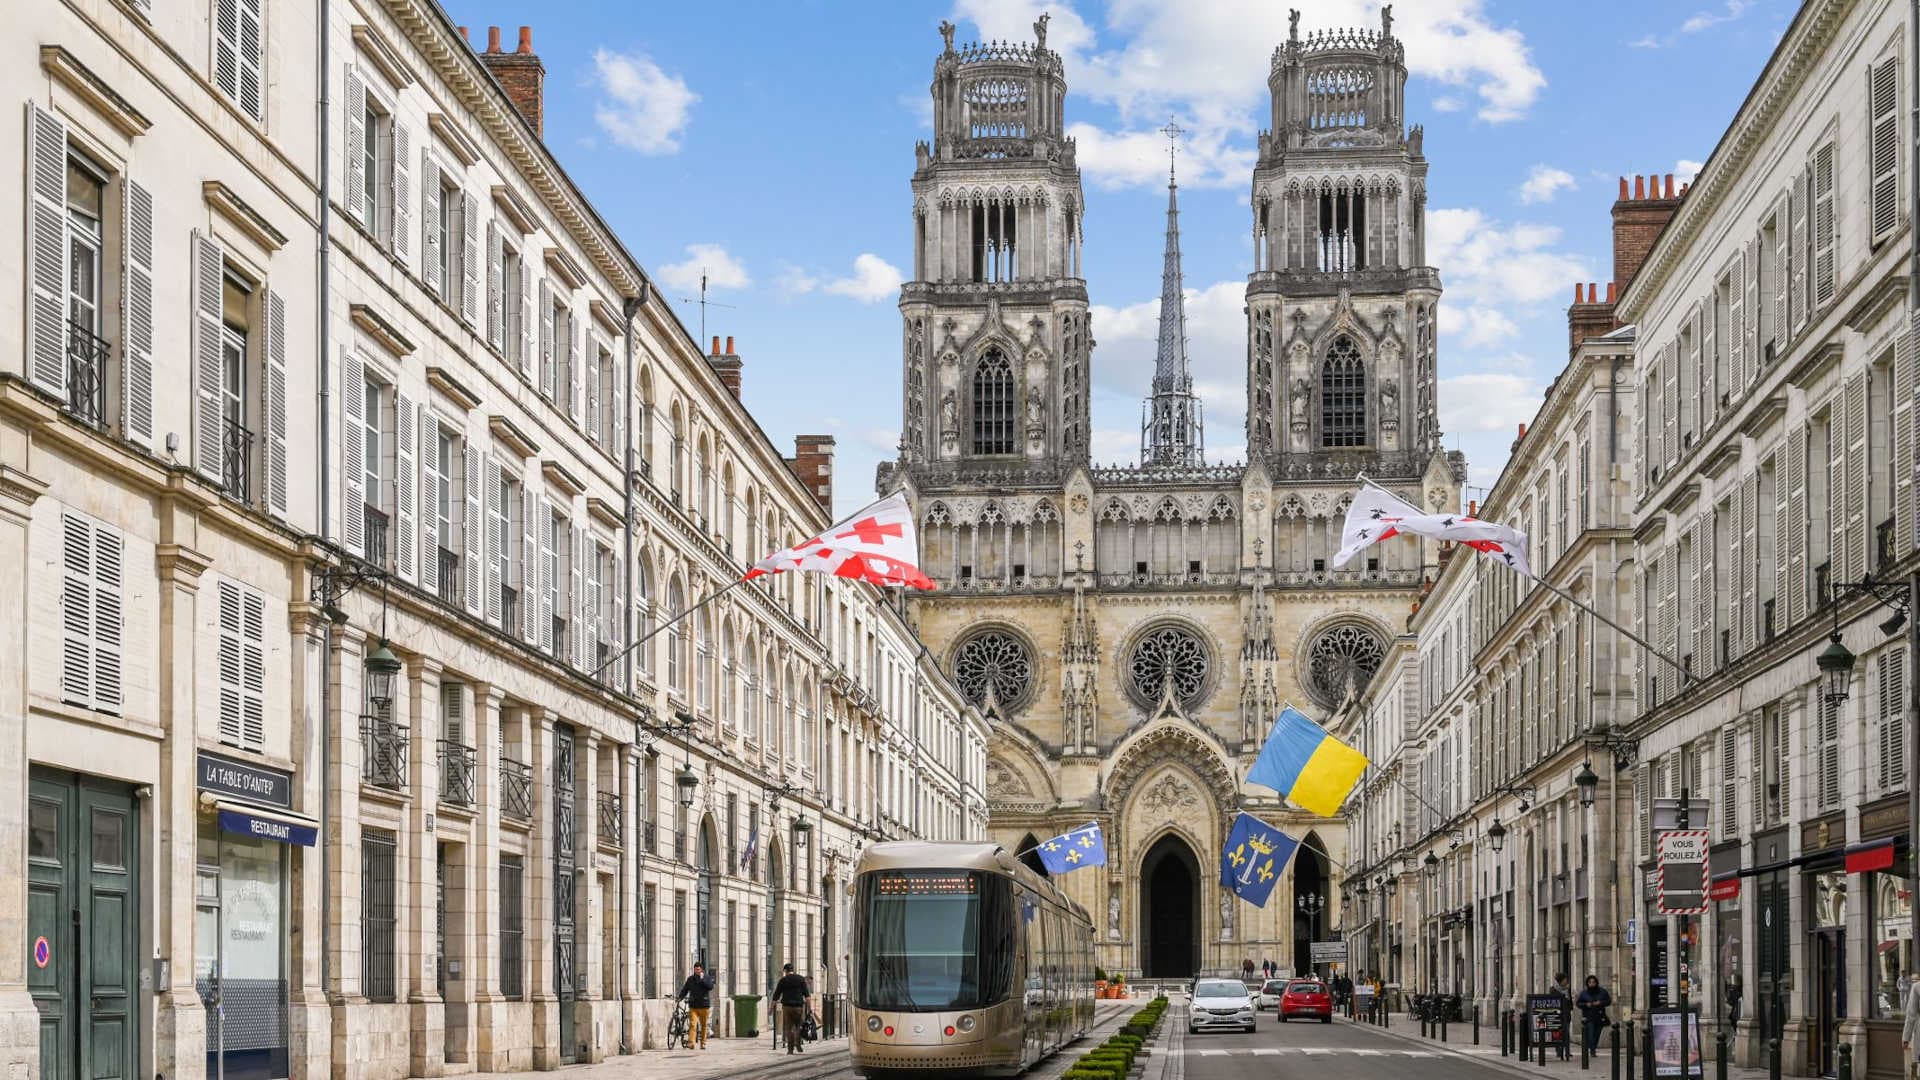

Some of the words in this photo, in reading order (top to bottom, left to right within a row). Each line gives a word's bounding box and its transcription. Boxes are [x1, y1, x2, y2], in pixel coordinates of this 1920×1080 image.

[206, 764, 217, 782] LA
[219, 768, 242, 788] TABLE
[243, 774, 274, 795] D'ANTEP
[250, 820, 290, 839] RESTAURANT
[1663, 852, 1695, 860] ROULEZ
